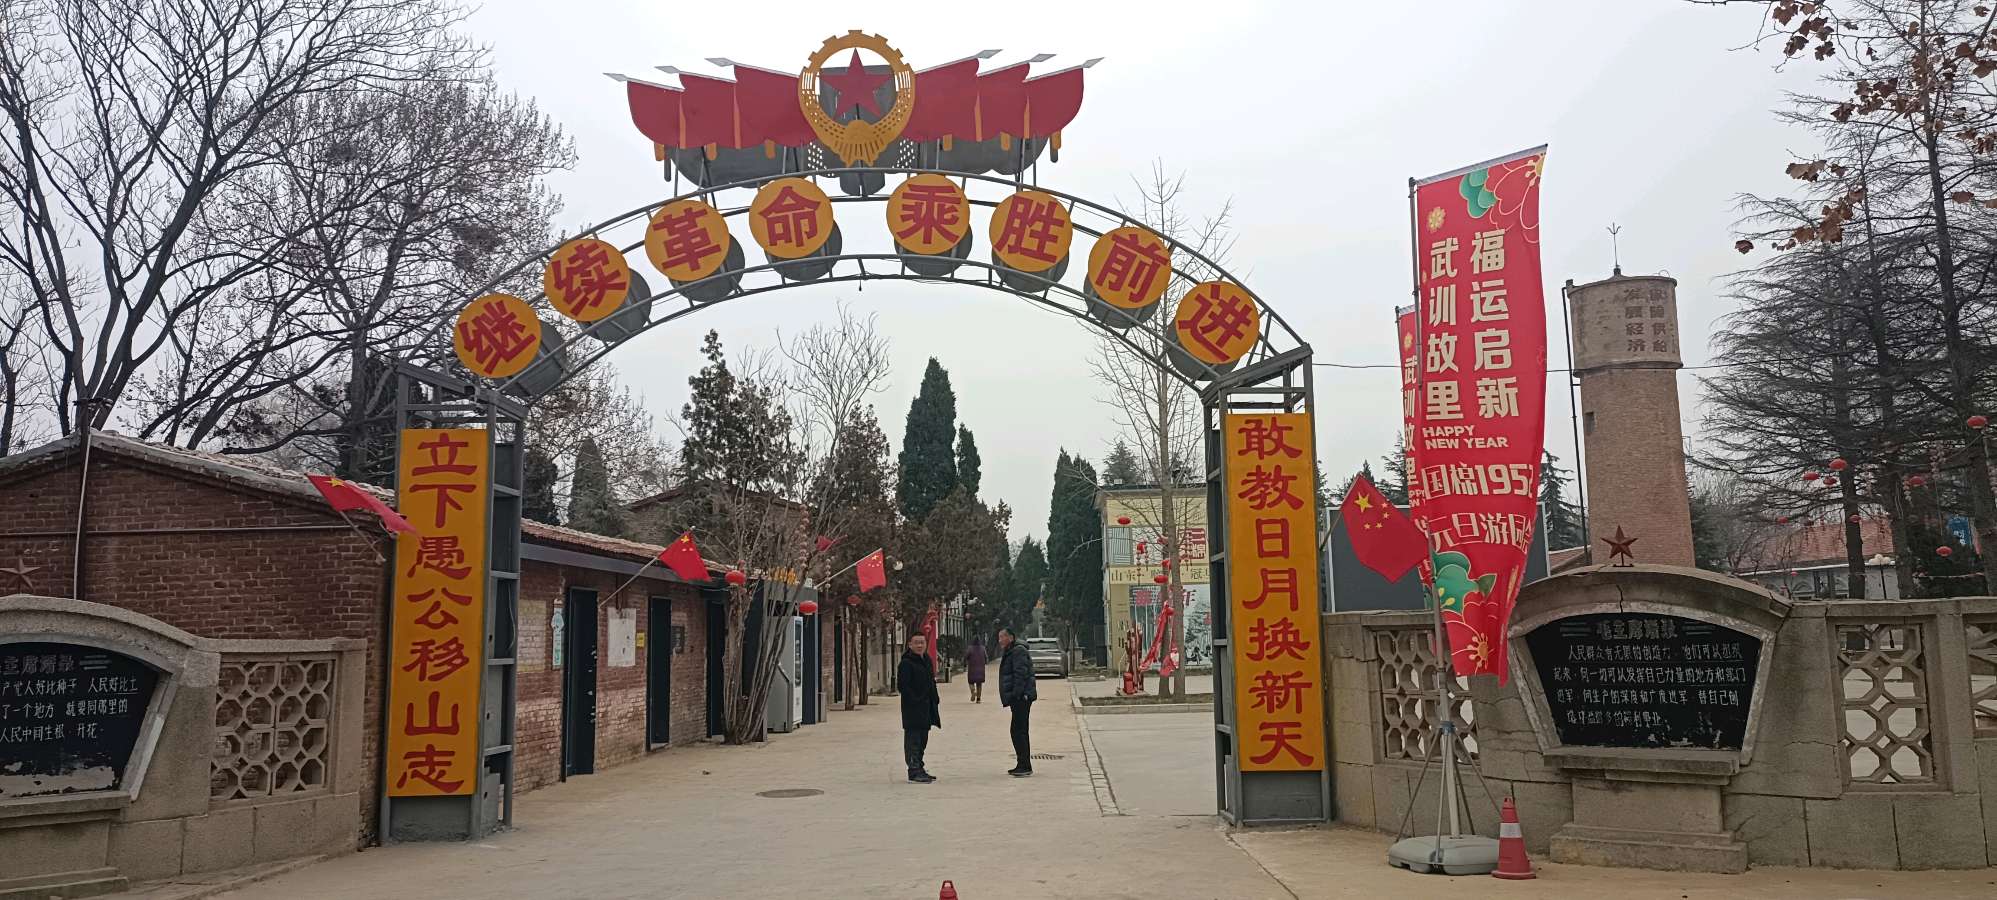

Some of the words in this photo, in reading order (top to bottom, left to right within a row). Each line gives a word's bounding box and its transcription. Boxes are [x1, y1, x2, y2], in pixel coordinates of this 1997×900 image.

[460, 174, 1259, 375] 继续革命乘胜前进
[1426, 237, 1464, 420] 武训故里
[1470, 228, 1519, 418] 福运启新
[1422, 425, 1475, 438] HAPPY
[1425, 438, 1459, 450] NEW
[1463, 437, 1509, 449] YEAR
[397, 432, 478, 793] 立下愚公移山志
[1237, 416, 1314, 766] 敢教日月换新天
